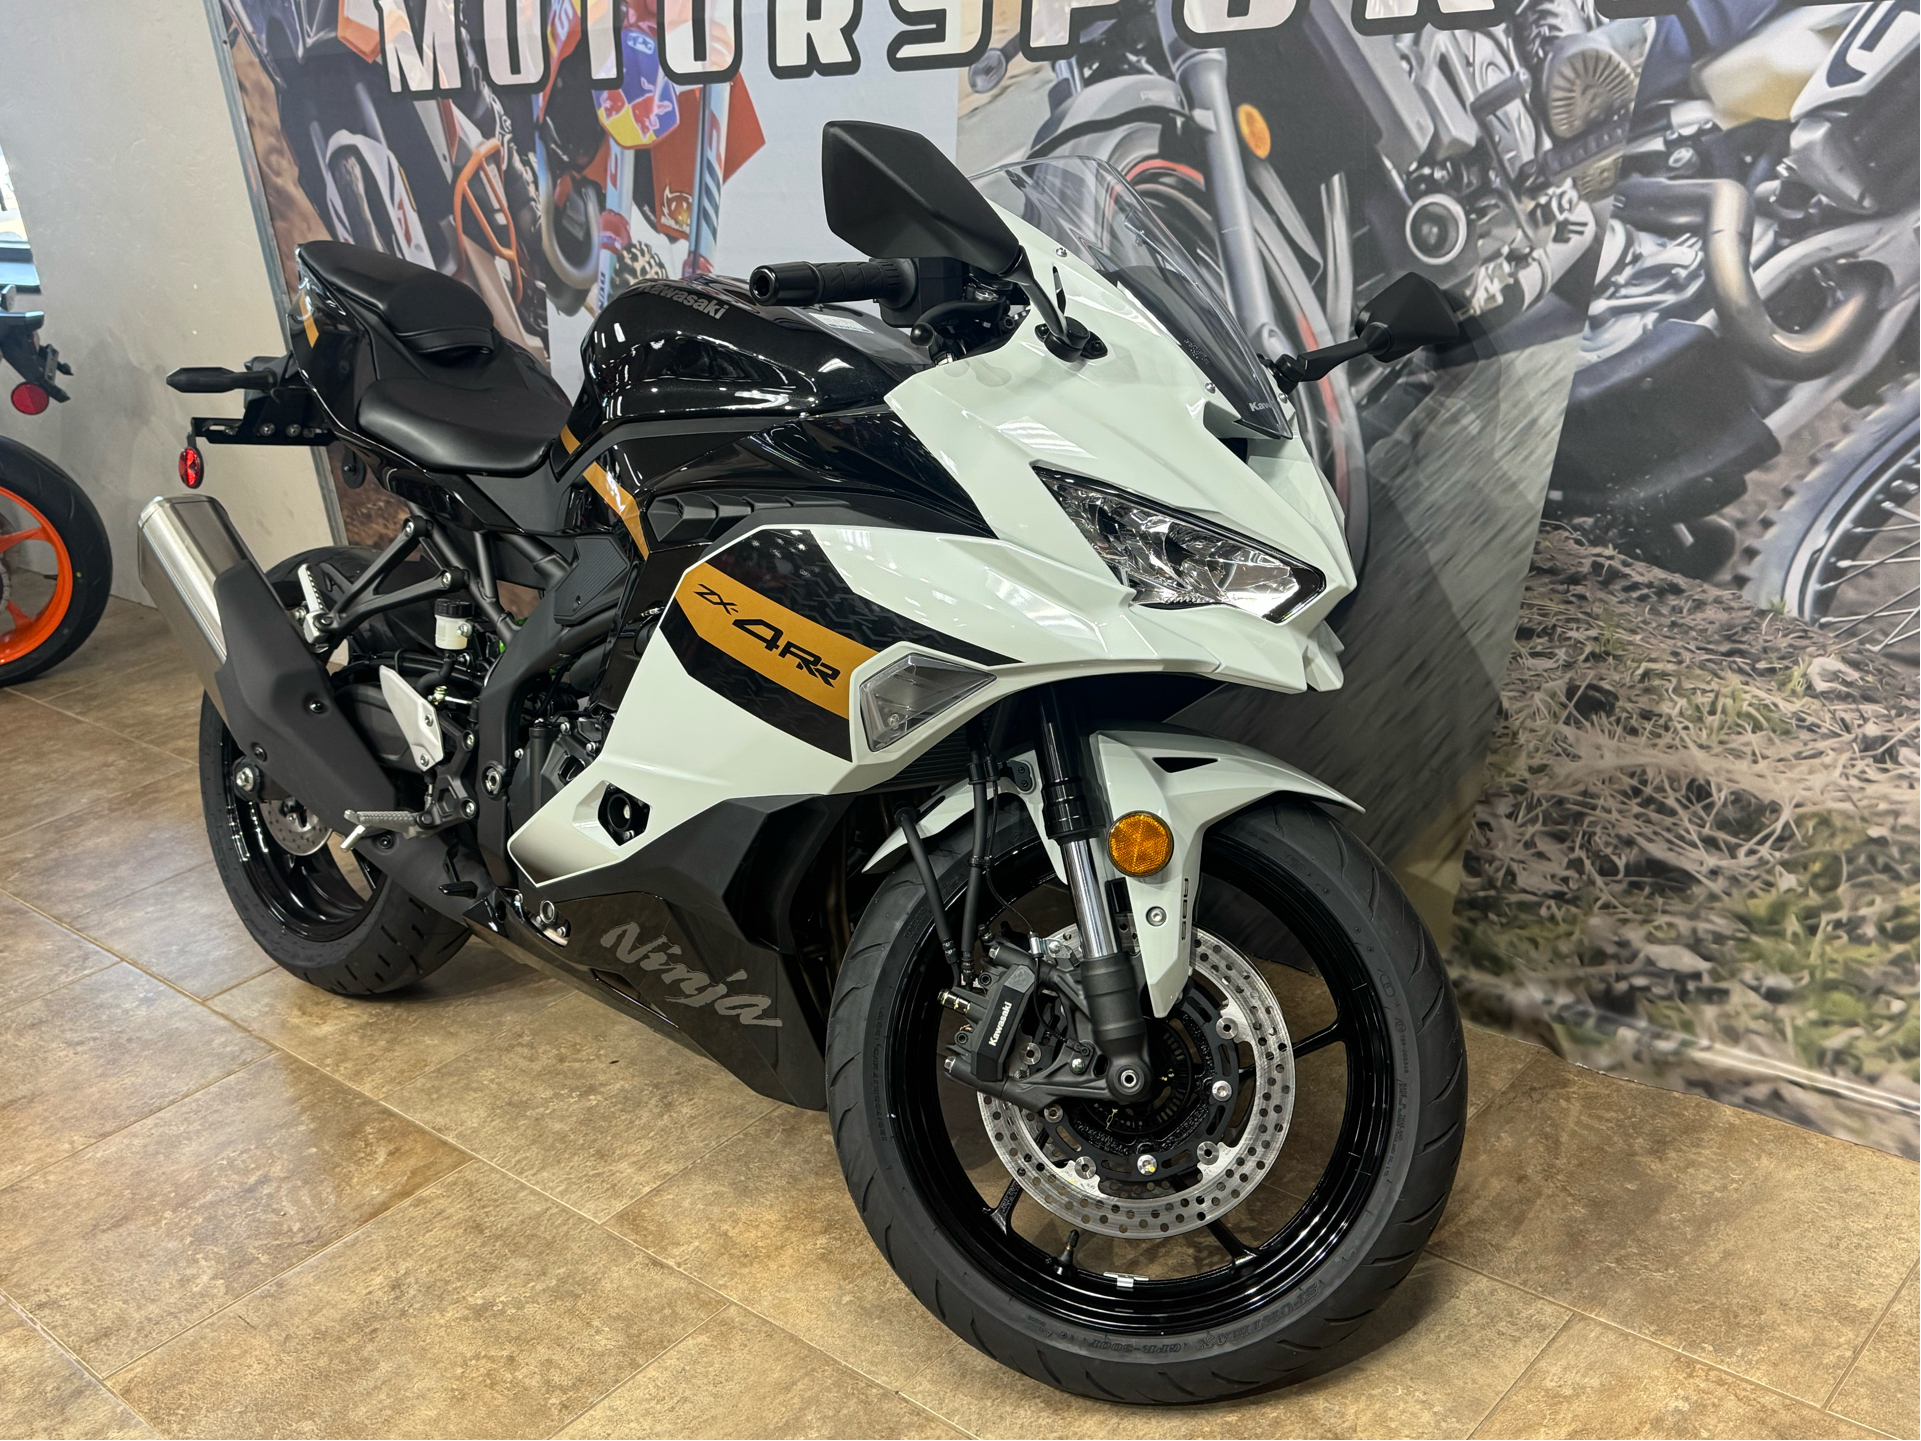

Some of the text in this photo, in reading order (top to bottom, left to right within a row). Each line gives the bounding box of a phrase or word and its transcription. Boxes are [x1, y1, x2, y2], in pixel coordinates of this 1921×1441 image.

[639, 283, 730, 319] Kawasaki
[600, 921, 783, 1028] Ninja
[988, 1001, 1013, 1047] Kawasaki
